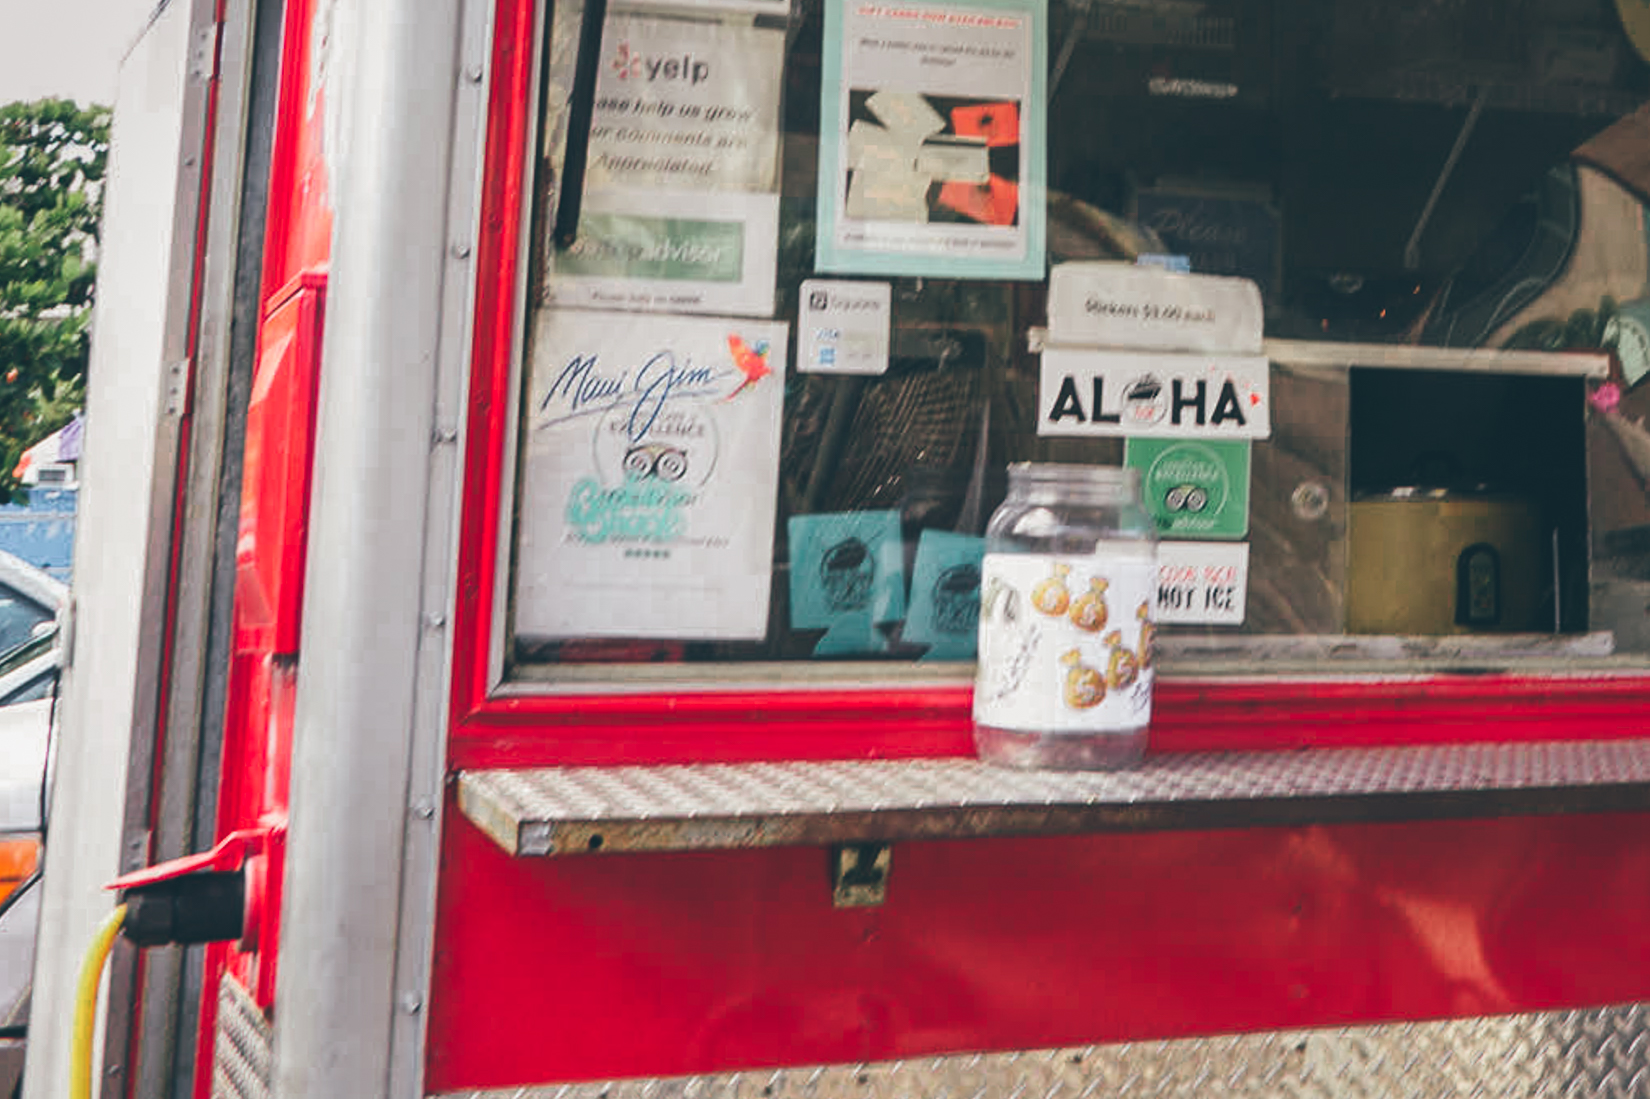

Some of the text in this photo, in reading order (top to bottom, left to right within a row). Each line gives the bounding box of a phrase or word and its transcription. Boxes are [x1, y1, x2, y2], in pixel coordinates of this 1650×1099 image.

[646, 55, 709, 87] yelp
[632, 99, 674, 118] help
[541, 349, 716, 443] Maui Jim
